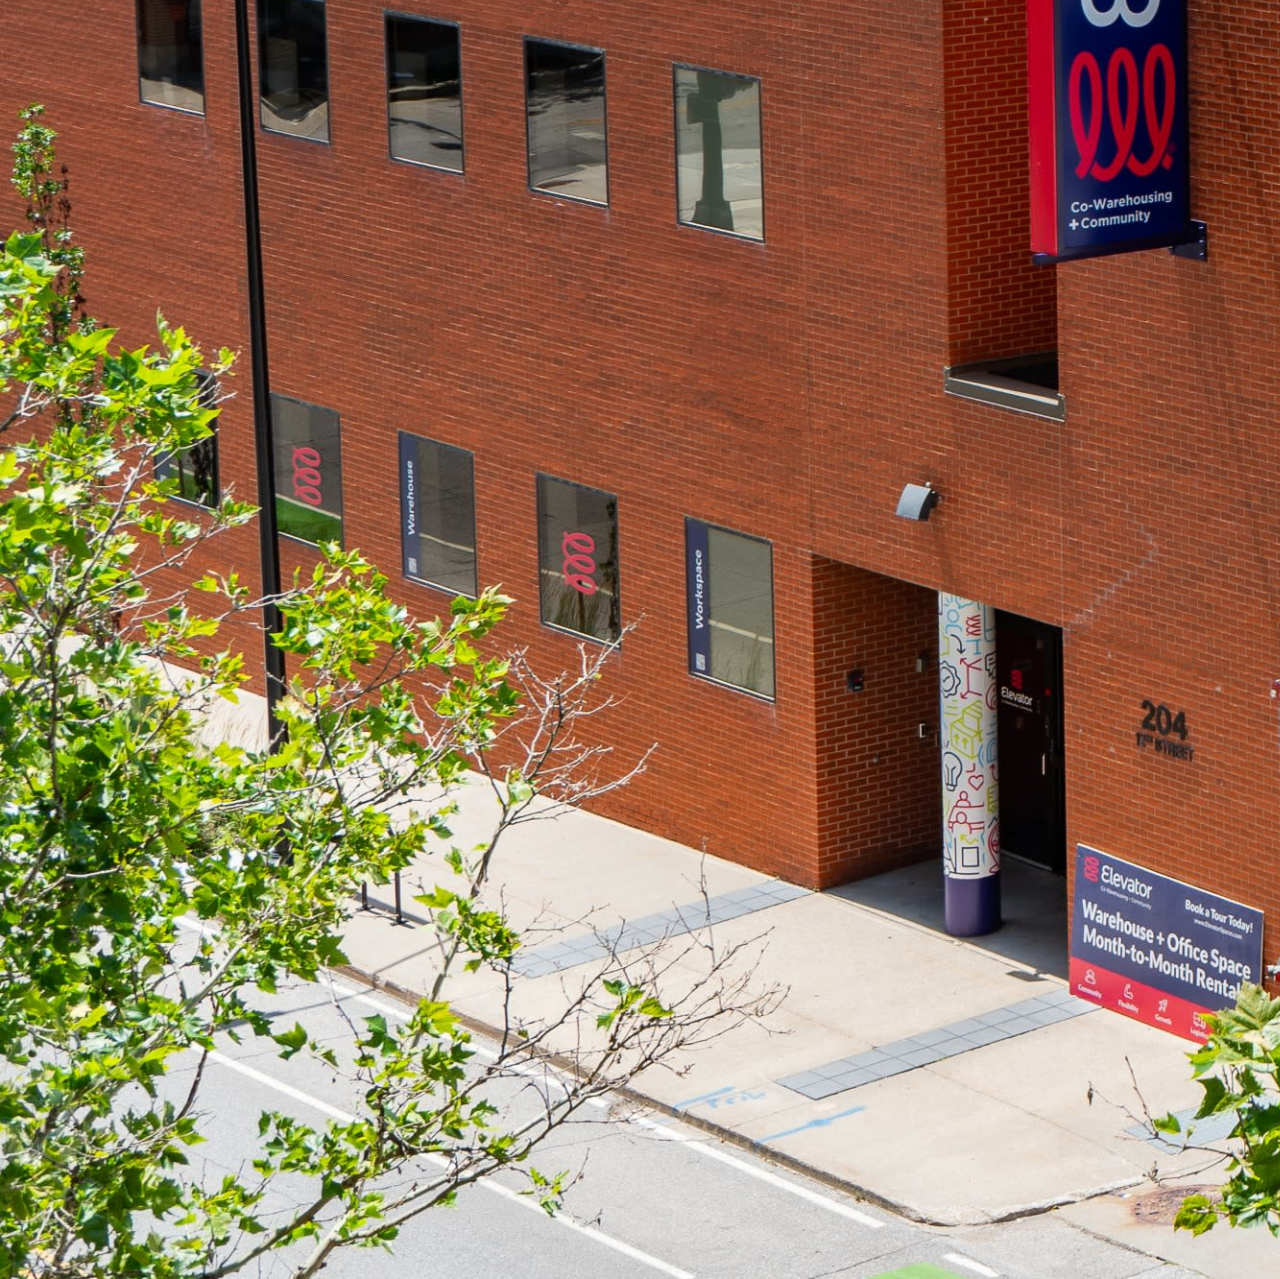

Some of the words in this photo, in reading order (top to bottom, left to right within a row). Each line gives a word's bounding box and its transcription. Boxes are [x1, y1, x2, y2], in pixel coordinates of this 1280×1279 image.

[1071, 191, 1173, 213] Co-Warehousing
[407, 460, 416, 536] Warehouse
[695, 549, 705, 629] Workspace
[1140, 700, 1188, 740] 204
[1101, 865, 1152, 899] Elevator
[1082, 899, 1154, 944] Warehouse
[1156, 932, 1165, 946] +
[1167, 933, 1209, 963] Office
[1210, 948, 1251, 980] Space
[1185, 899, 1204, 917] Book
[1211, 909, 1227, 924] Tour
[1228, 915, 1253, 933] Today!
[1083, 925, 1194, 984] Month-to-Month
